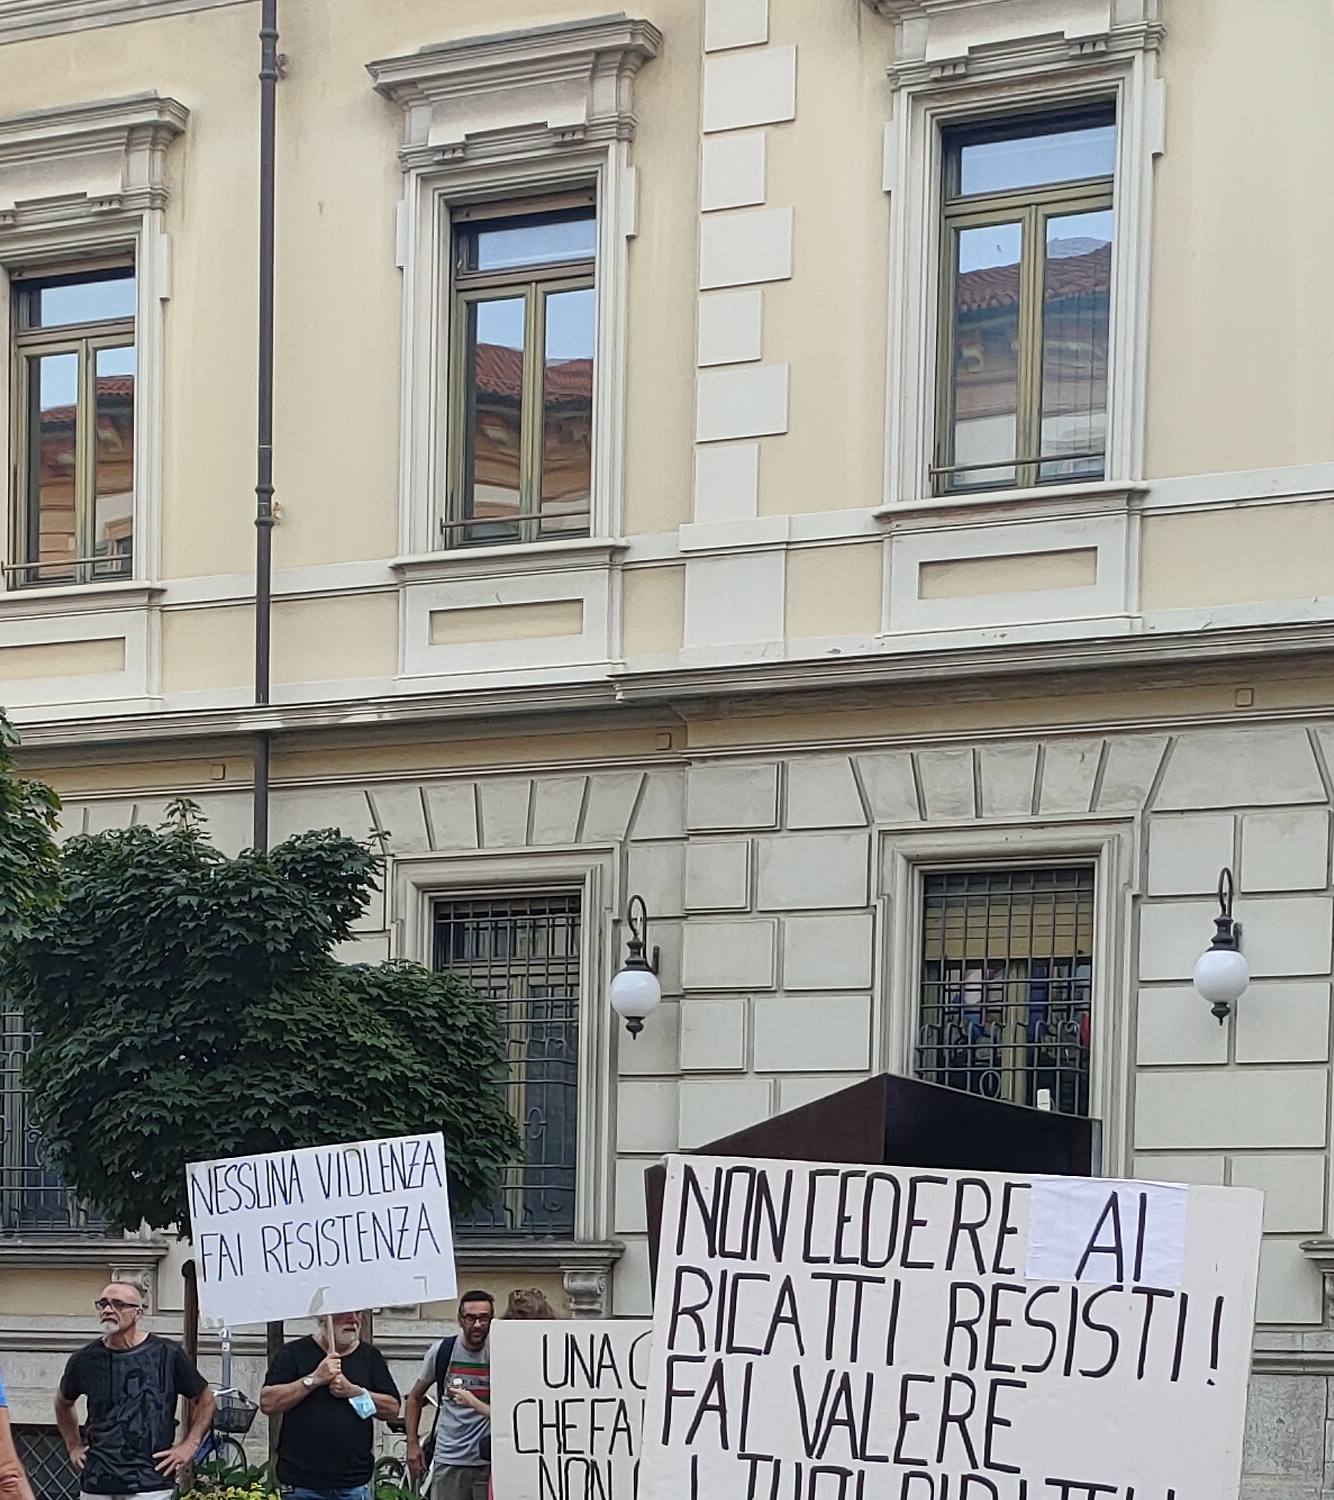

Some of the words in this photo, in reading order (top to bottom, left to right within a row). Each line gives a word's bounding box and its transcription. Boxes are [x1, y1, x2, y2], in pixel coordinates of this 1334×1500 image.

[190, 1154, 305, 1219] NESSUNA
[315, 1139, 443, 1200] VIOLENZA
[676, 1163, 793, 1263] NON
[802, 1168, 1033, 1276] CEDERE
[1075, 1190, 1148, 1284] AI
[199, 1231, 245, 1283] FAI
[261, 1201, 442, 1275] RESISTENZA
[542, 1332, 623, 1390] UNA
[666, 1265, 903, 1367] RICATTI
[661, 1354, 754, 1453] FAI
[793, 1363, 1028, 1475] VALERE
